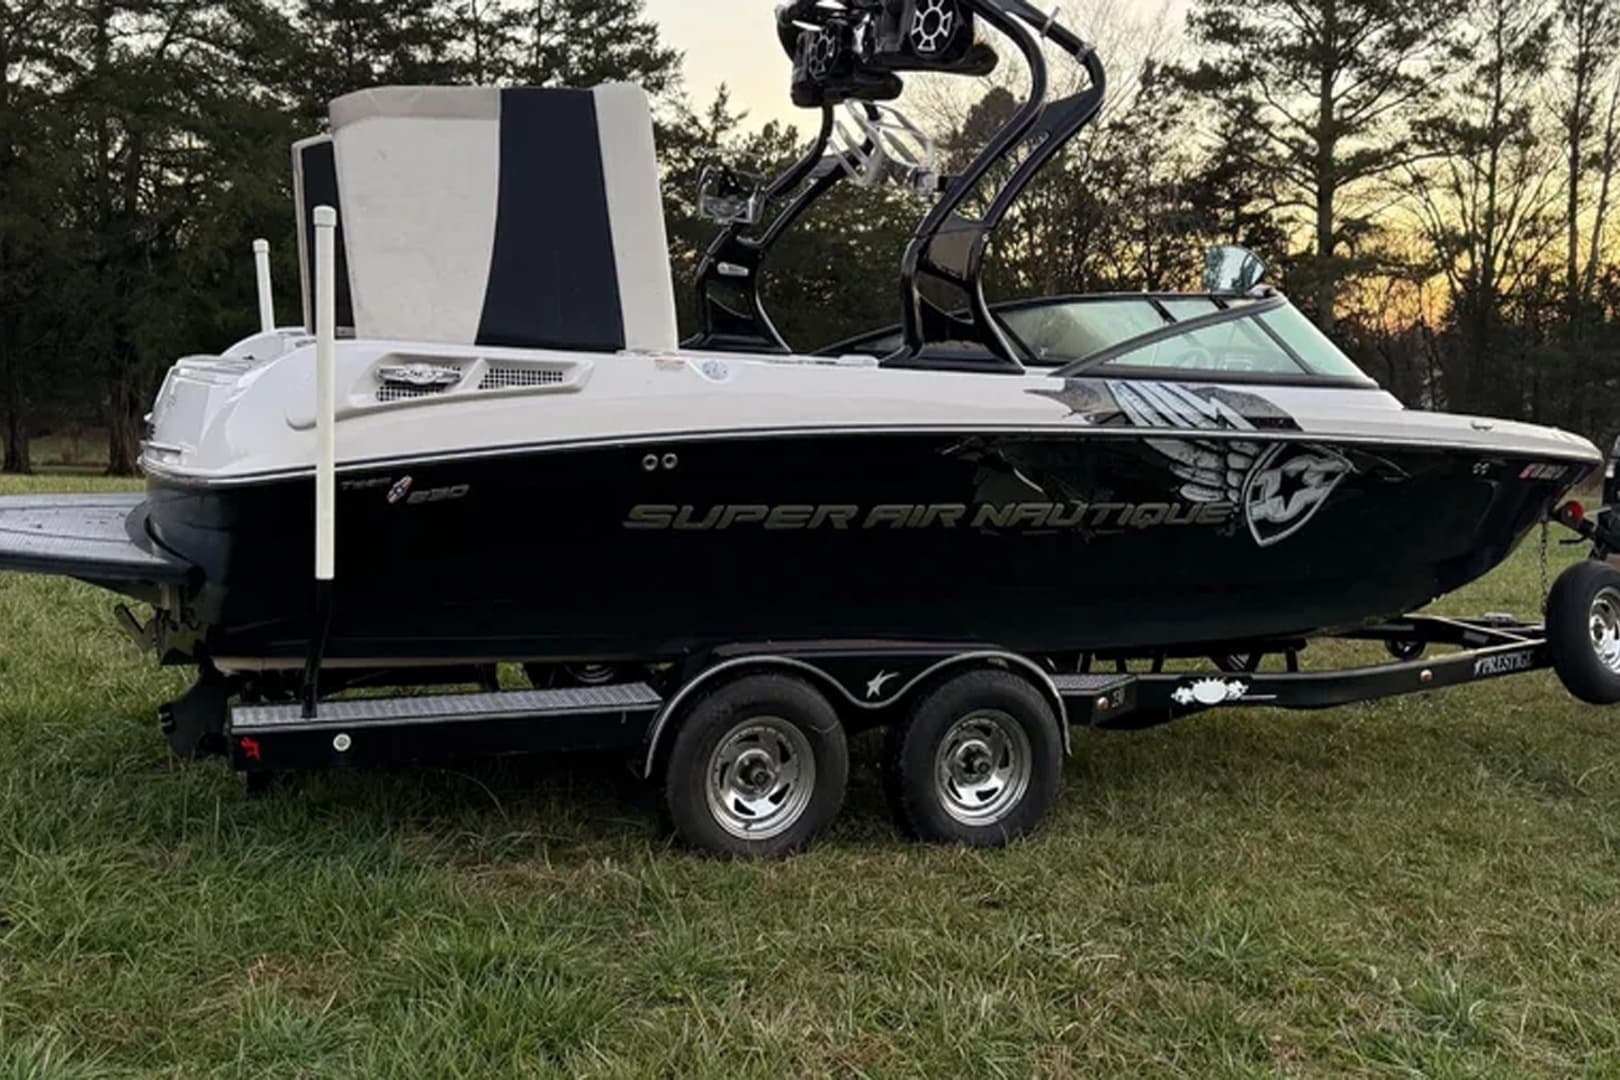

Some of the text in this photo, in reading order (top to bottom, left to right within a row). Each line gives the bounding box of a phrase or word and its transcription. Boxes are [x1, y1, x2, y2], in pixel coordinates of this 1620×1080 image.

[622, 501, 1232, 530] SUPER AIR NAUTIQUE
